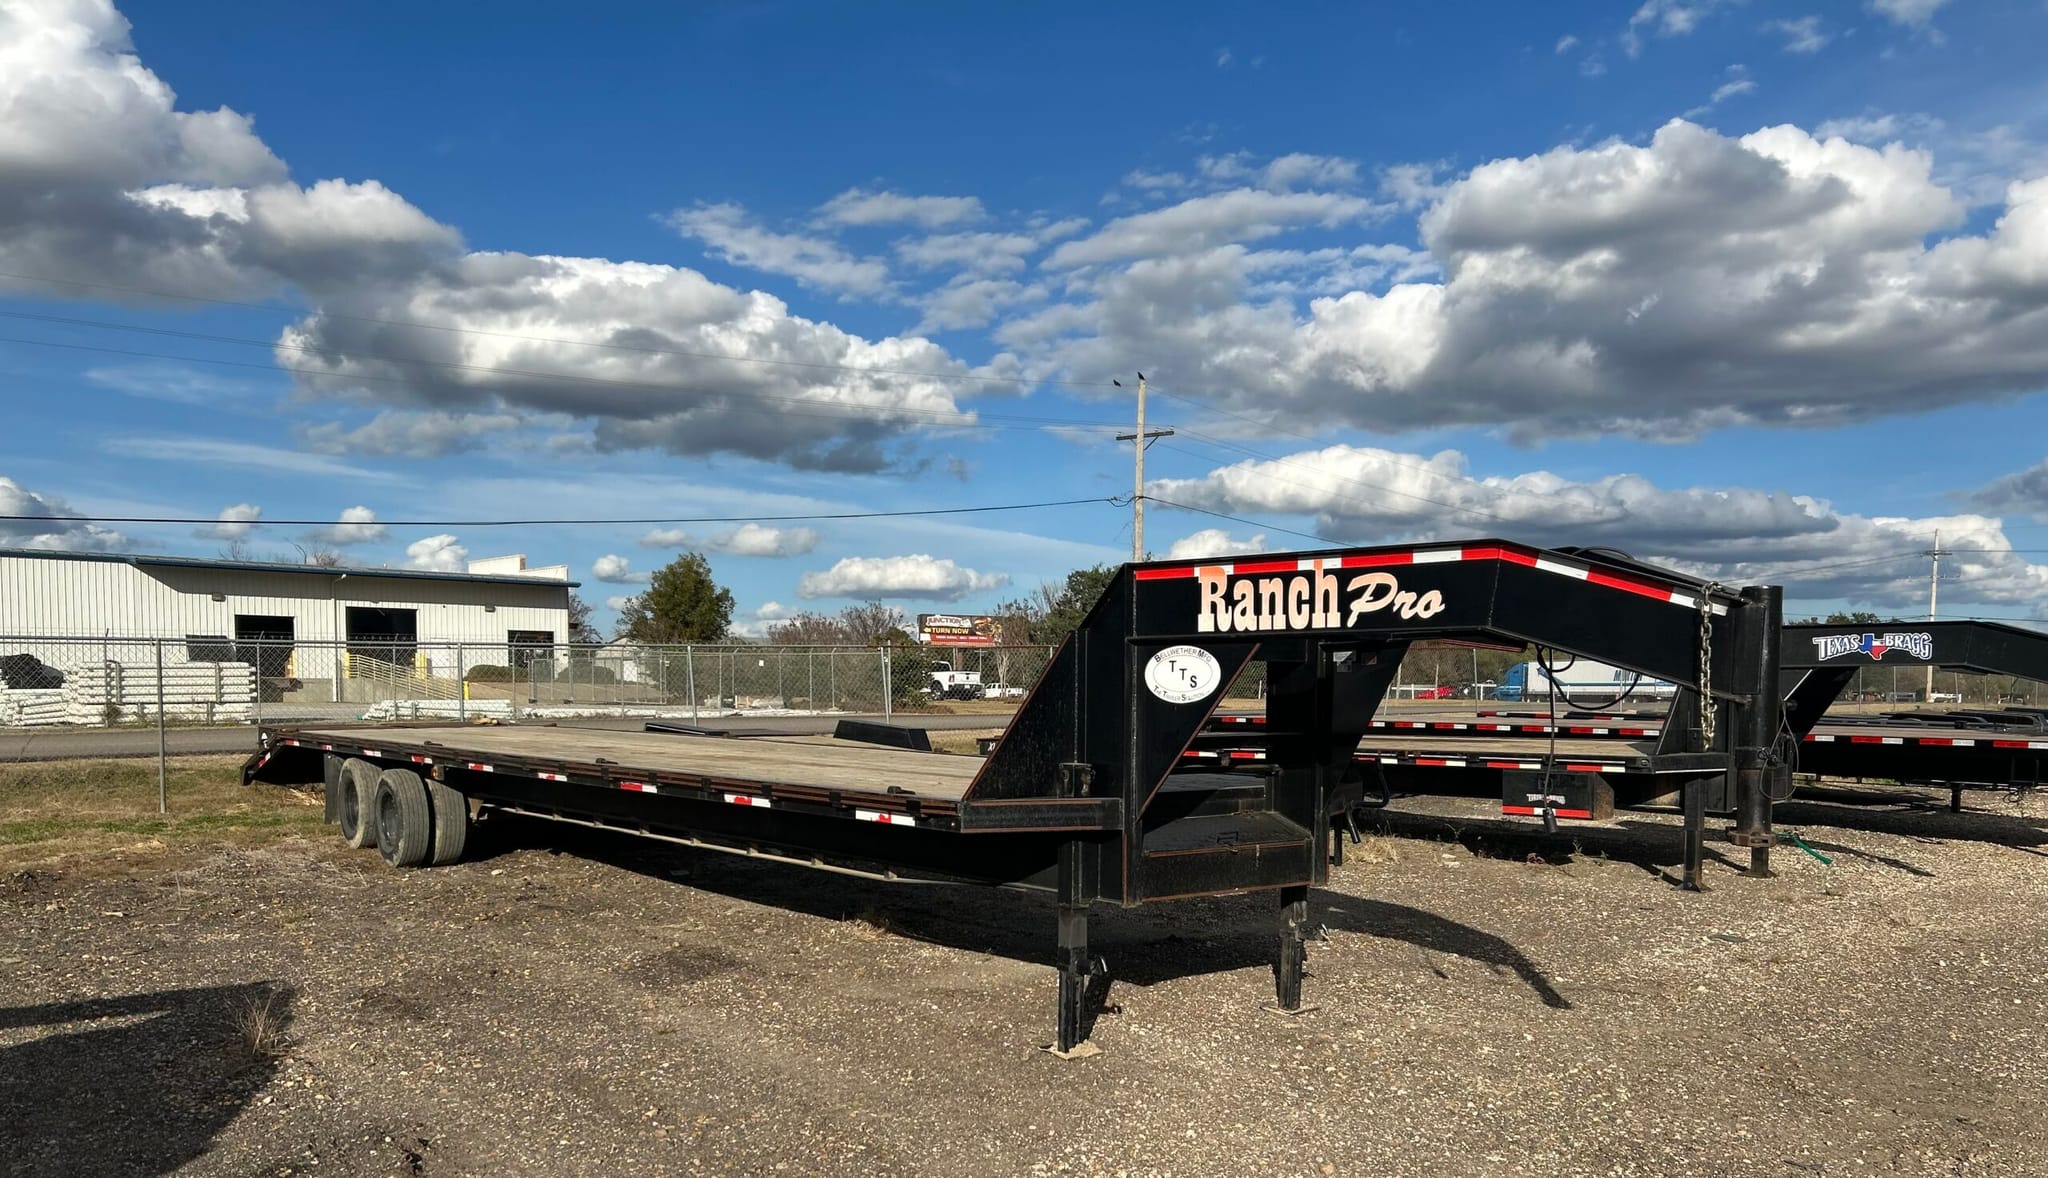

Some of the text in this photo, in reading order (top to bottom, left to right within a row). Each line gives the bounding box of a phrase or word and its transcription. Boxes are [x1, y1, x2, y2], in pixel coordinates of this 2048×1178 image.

[1197, 558, 1446, 633] Ranch Pro
[1154, 648, 1213, 662] BELLWETHER MFG
[1813, 632, 1933, 661] TEXAS BRAGG
